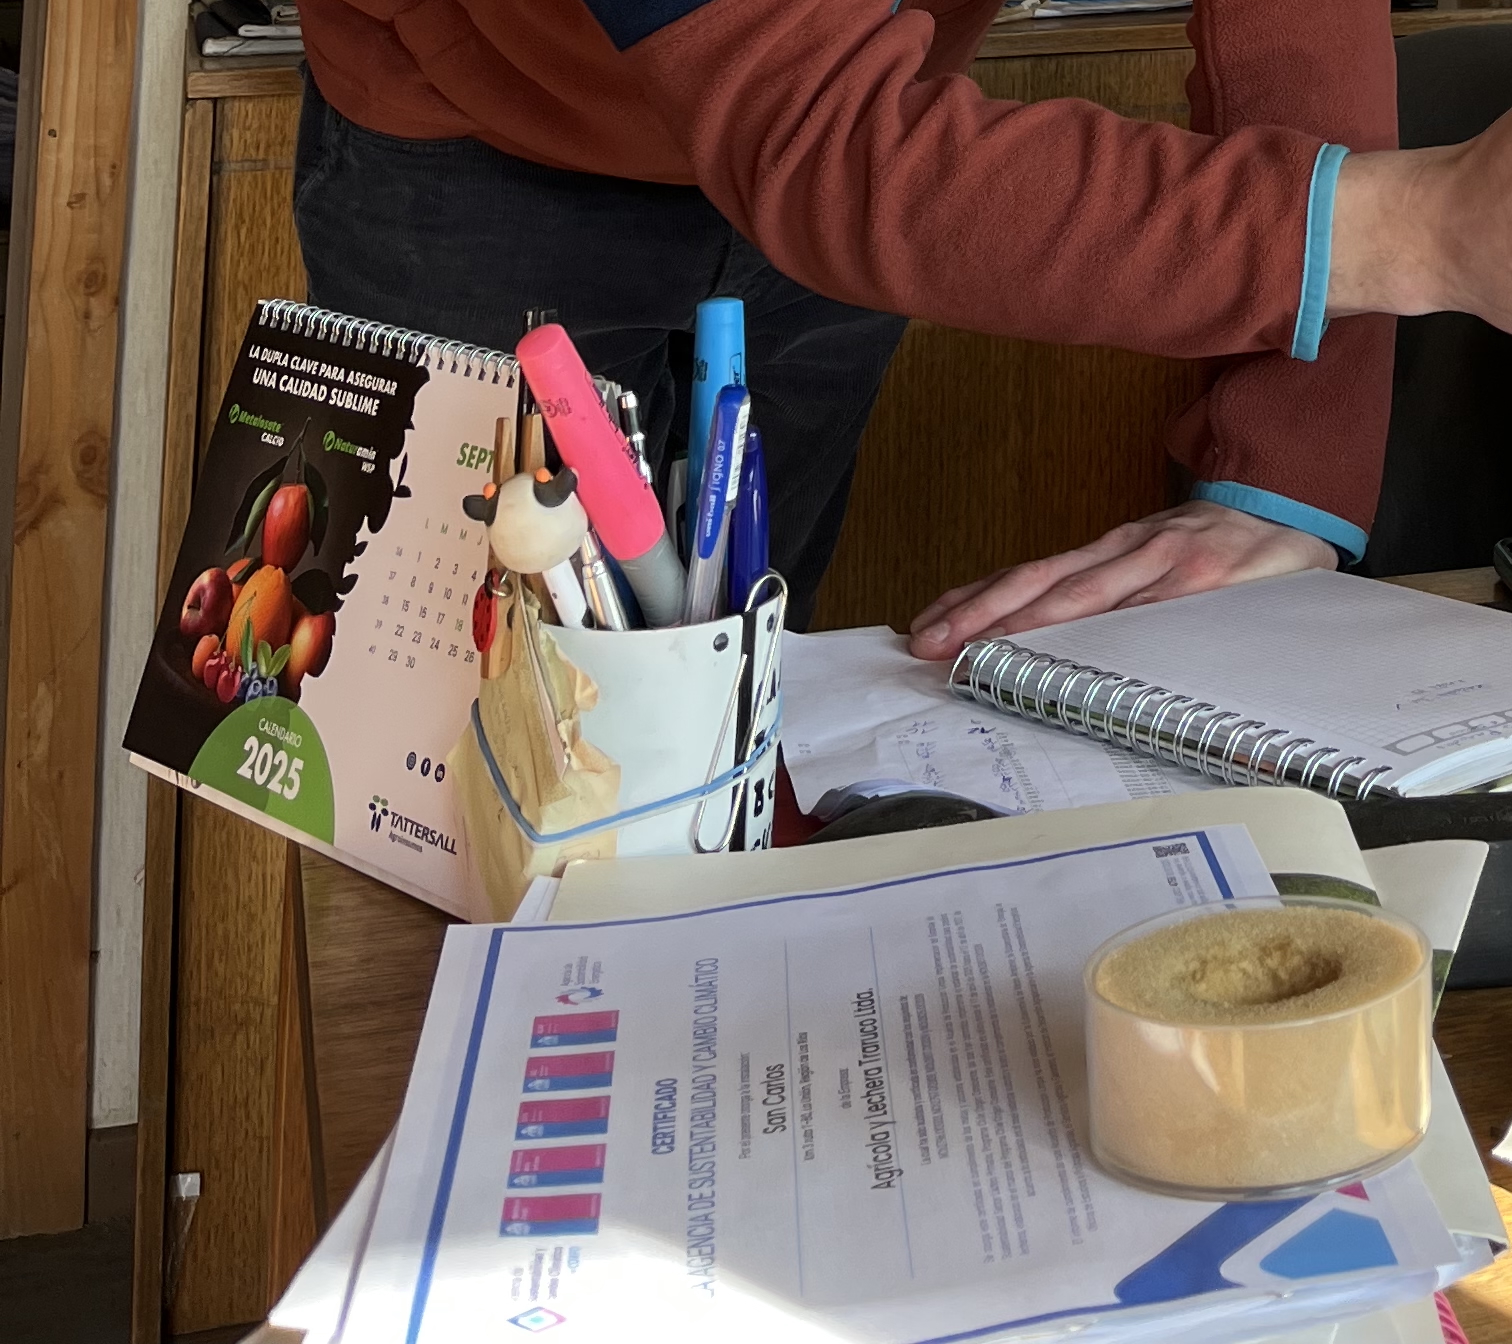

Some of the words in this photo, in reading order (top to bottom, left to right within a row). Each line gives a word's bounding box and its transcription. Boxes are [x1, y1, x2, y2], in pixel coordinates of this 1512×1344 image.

[248, 344, 260, 359] LA
[260, 347, 289, 368] DUPLA
[290, 355, 320, 375] CLAVE
[318, 362, 345, 382] PARA
[346, 370, 398, 396] ASEGURAR
[252, 367, 278, 389] UNA
[279, 374, 328, 402] CALIDAD
[329, 387, 380, 416] SUBLIME
[261, 432, 285, 447] CALCIO
[410, 575, 417, 587] 8
[428, 581, 435, 594] 9
[443, 587, 453, 600] 10
[434, 557, 441, 569] 2
[452, 563, 459, 575] 3
[471, 570, 478, 582] 4
[401, 599, 411, 613] 15
[419, 605, 428, 619] 16
[435, 612, 446, 625] 17
[454, 618, 464, 632] 18
[388, 648, 399, 663] 29
[405, 655, 416, 669] 30
[394, 624, 405, 638] 22
[411, 630, 423, 644] 23
[430, 637, 441, 651] 24
[447, 643, 459, 658] 25
[464, 650, 475, 663] 26
[258, 718, 302, 748] CALENDARIO
[236, 735, 304, 800] 2025
[390, 811, 458, 855] TATTERSALL
[688, 958, 719, 1015] CLIMÁTICO
[850, 987, 876, 1018] Ltda.
[691, 1016, 718, 1062] CAMBIO
[858, 1018, 882, 1066] Traruco
[690, 1064, 716, 1073] Y
[760, 1064, 786, 1106] Carlos
[859, 1066, 888, 1119] Lechera
[651, 1078, 678, 1156] CERTIFICADO
[688, 1075, 717, 1190] SUSTENTABILIDAD
[762, 1107, 787, 1134] San
[867, 1121, 896, 1129] y
[864, 1131, 904, 1189] Agrícola
[687, 1191, 716, 1212] DE
[687, 1212, 718, 1276] AGENCIA
